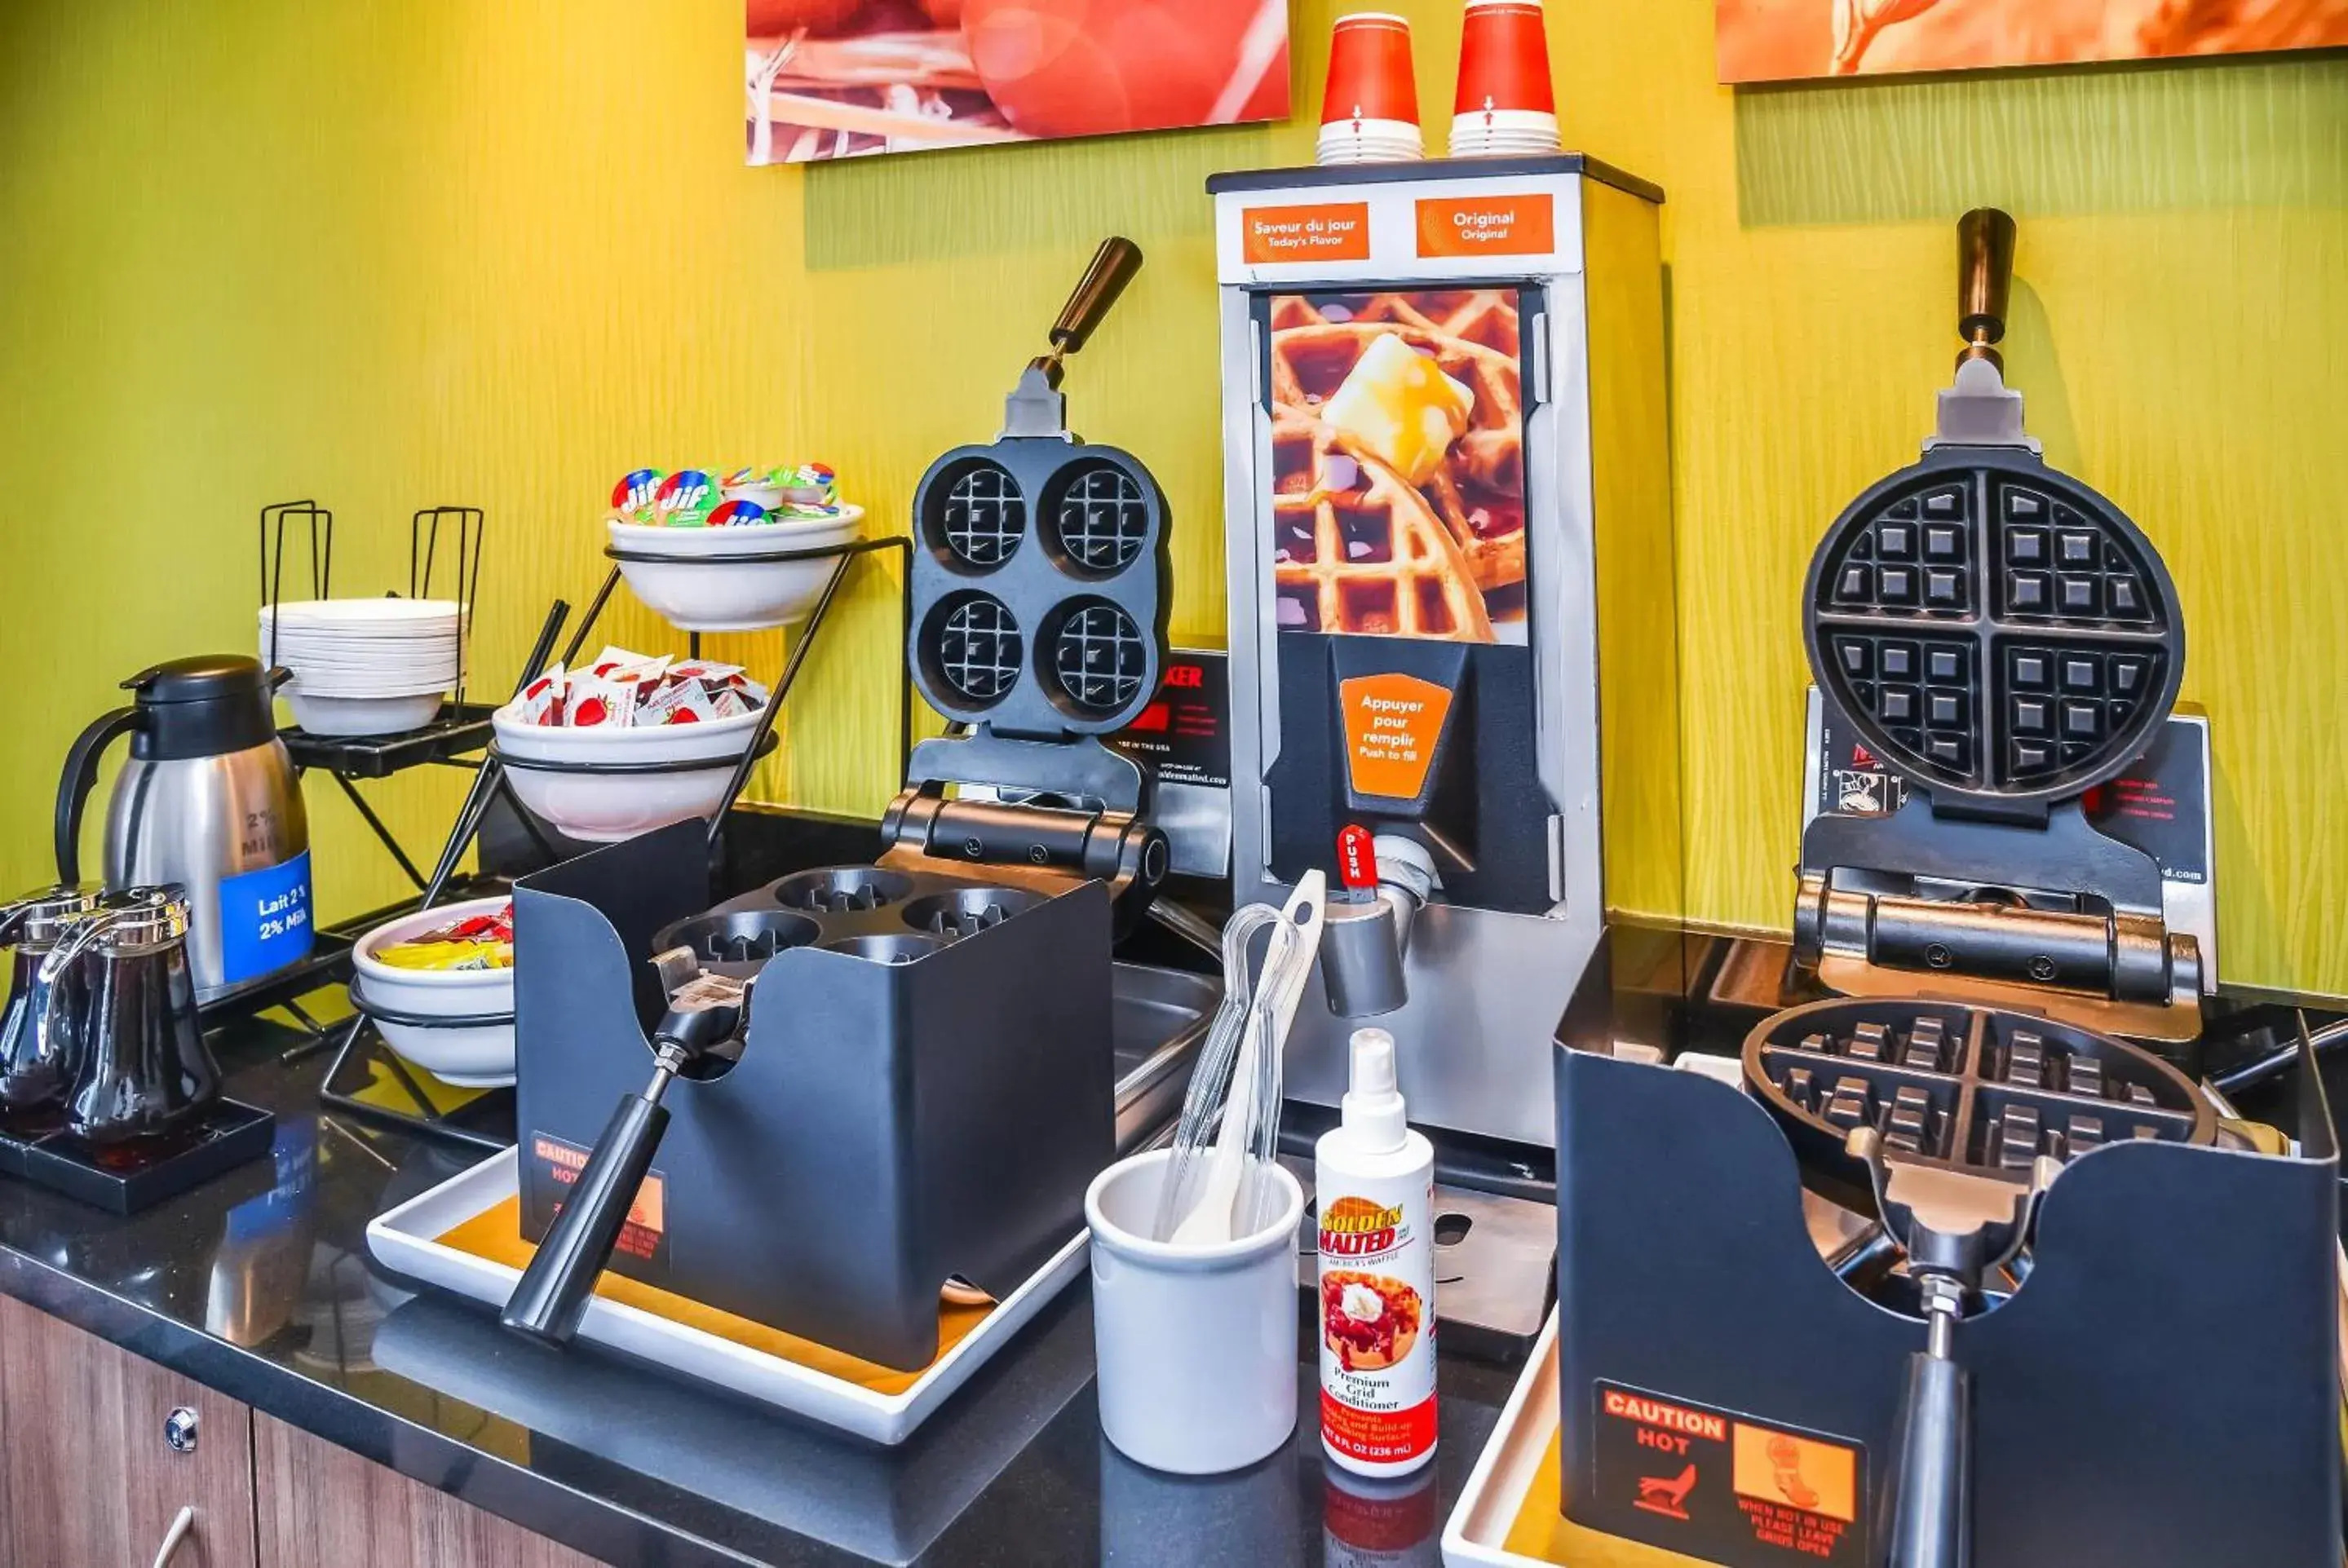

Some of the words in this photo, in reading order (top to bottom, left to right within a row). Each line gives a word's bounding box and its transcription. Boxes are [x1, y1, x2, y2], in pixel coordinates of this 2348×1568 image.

[1254, 221, 1302, 235] Saveur
[1305, 219, 1324, 232] du
[1328, 219, 1356, 234] jour
[1453, 209, 1514, 228] Original
[1268, 236, 1307, 249] Today's
[1310, 235, 1343, 245] Flavor
[1461, 227, 1507, 241] Original
[621, 477, 663, 513] Jif
[661, 484, 710, 510] Jif
[1361, 694, 1424, 714] Appuyer
[1373, 715, 1408, 729] pour
[1363, 731, 1416, 749] remplir
[1360, 746, 1385, 759] Push
[1388, 751, 1400, 761] to
[1403, 751, 1417, 762] fill
[1345, 833, 1361, 879] PUSH
[259, 893, 289, 917] Lait
[290, 888, 298, 906] 2
[259, 919, 284, 940] 2%
[285, 907, 307, 931] Milk
[538, 1142, 588, 1169] CAUTIO
[1321, 1203, 1403, 1232] GOLDEN
[1320, 1226, 1395, 1255] MALTED
[1334, 1366, 1390, 1388] Premium
[1328, 1384, 1399, 1410] Conditioner
[1346, 1384, 1375, 1398] Grid
[1606, 1394, 1722, 1438] CAUTION
[1353, 1442, 1368, 1455] OZ
[1370, 1446, 1391, 1456] (236
[1637, 1427, 1691, 1455] HOT
[1738, 1500, 1774, 1517] WHEN
[1776, 1507, 1800, 1524] NOT
[1751, 1513, 1794, 1535] PLEASE
